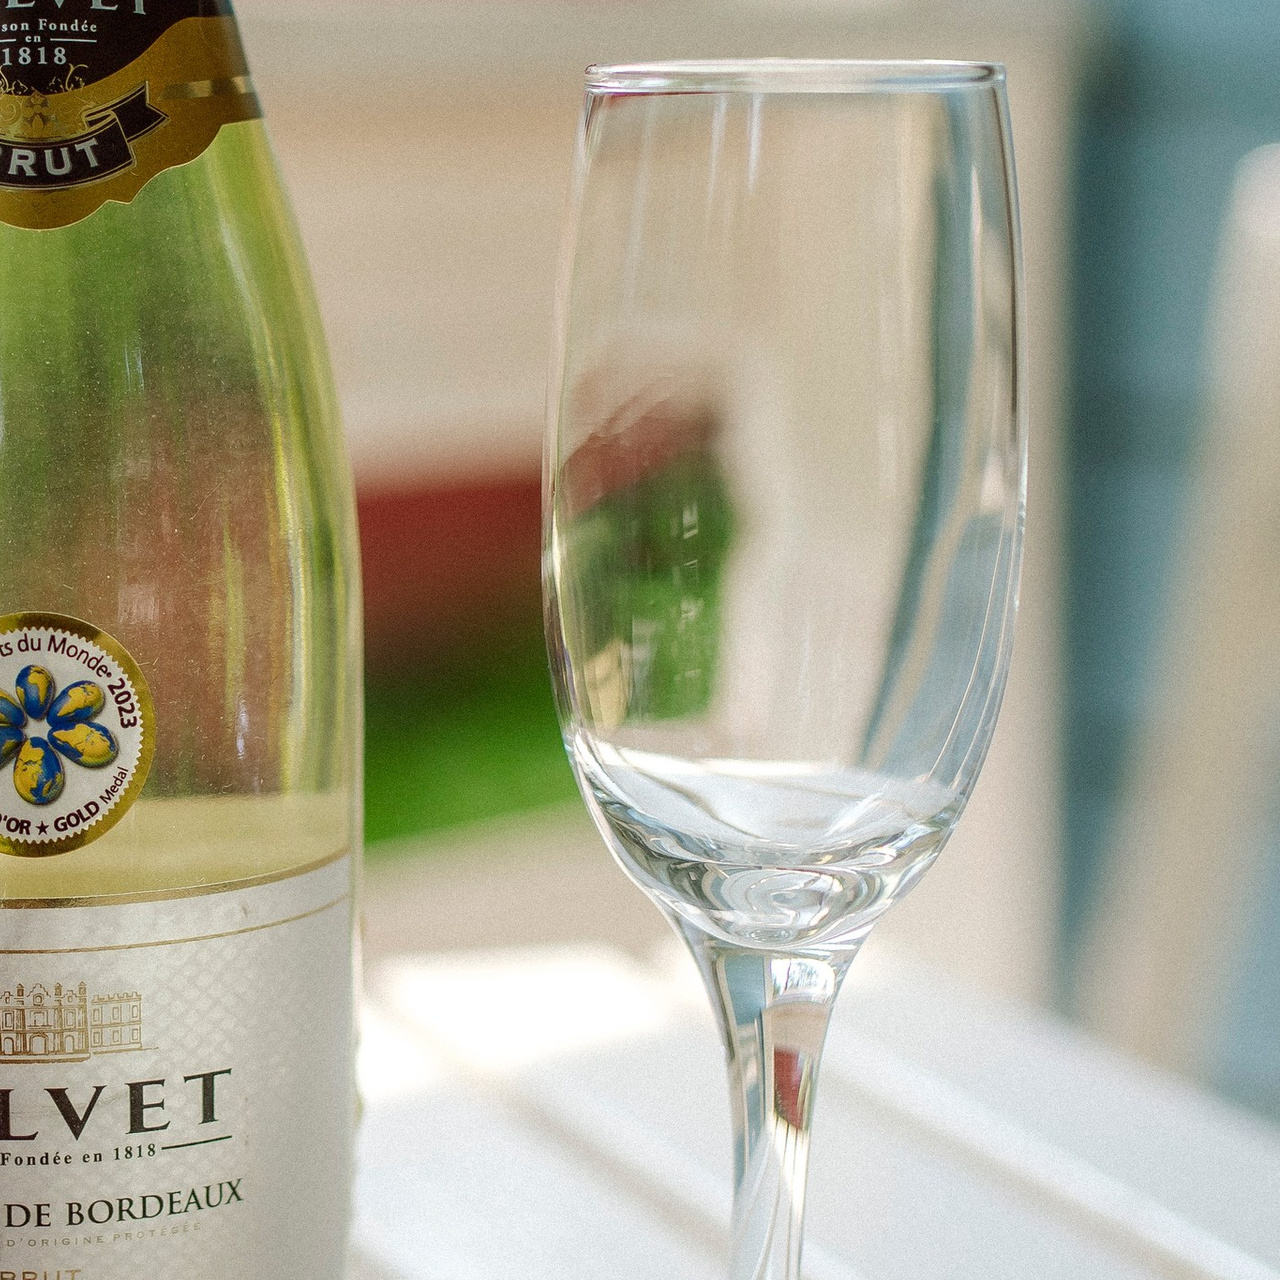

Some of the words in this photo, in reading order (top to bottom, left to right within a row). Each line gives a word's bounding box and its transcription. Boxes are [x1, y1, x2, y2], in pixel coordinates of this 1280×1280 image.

[38, 19, 97, 33] Fondée
[25, 35, 41, 43] en
[2, 47, 67, 66] 1818
[17, 633, 41, 652] du
[107, 677, 138, 729] 2023
[54, 800, 100, 833] GOLD
[99, 766, 129, 805] Medal
[0, 1151, 72, 1166] Fondée
[82, 1152, 103, 1163] en
[114, 1143, 156, 1160] 1818
[4, 1203, 52, 1228] DE
[66, 1178, 244, 1227] BORDEAUX
[7, 1235, 104, 1248] D'ORIGINE
[113, 1222, 201, 1242] PROTÉGÉE
